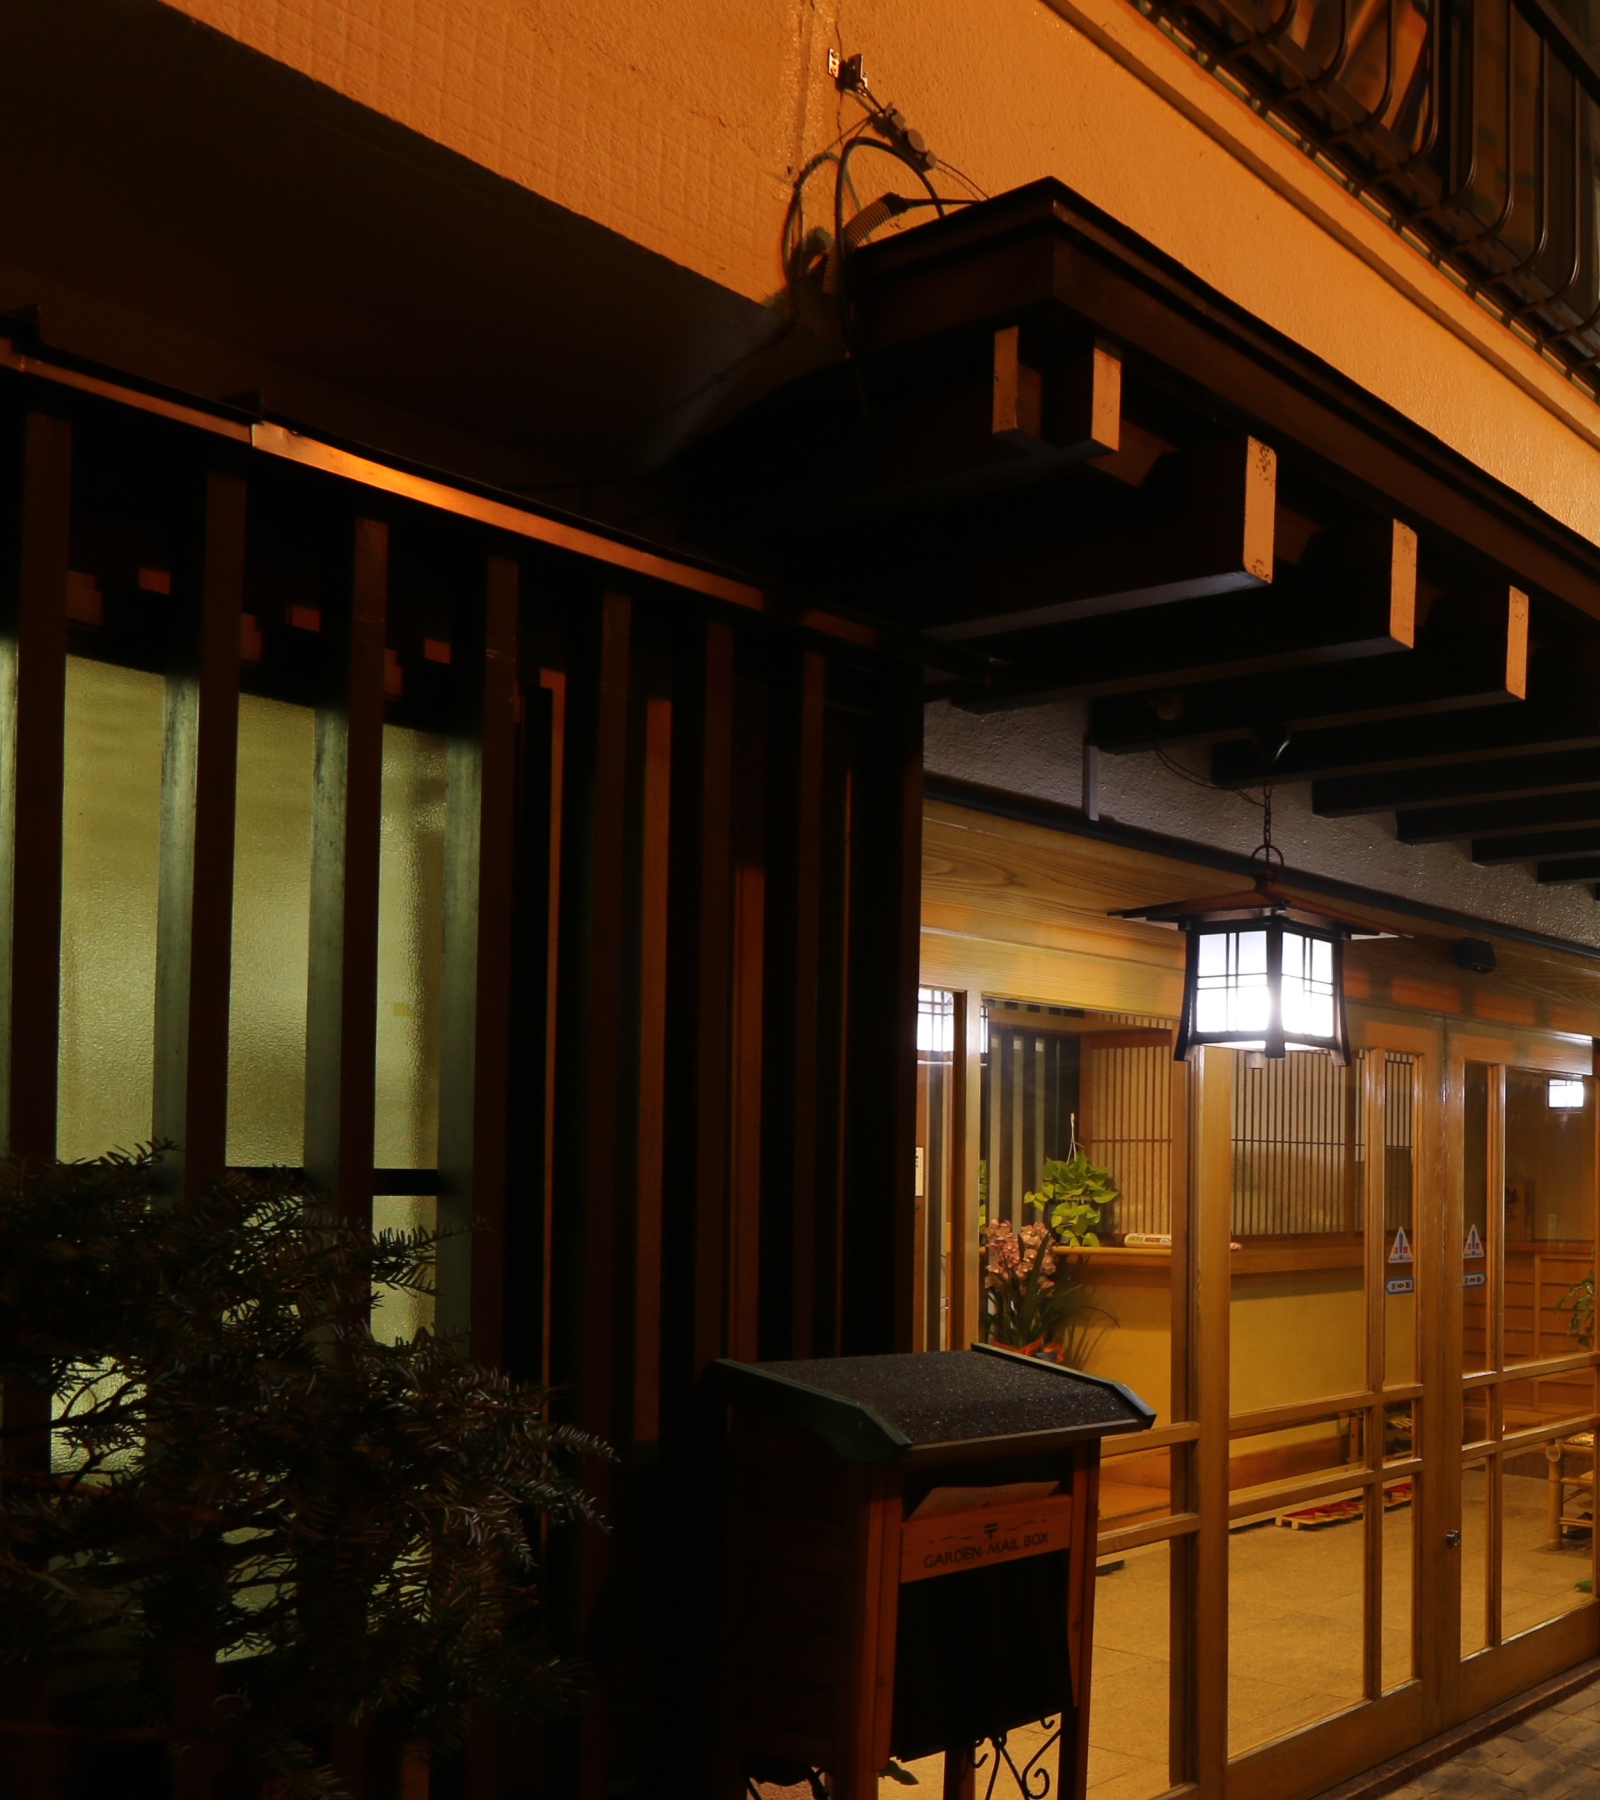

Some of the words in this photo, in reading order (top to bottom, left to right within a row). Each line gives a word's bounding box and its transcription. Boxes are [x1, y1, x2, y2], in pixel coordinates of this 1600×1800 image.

[923, 1546, 982, 1569] GARDEN
[987, 1538, 1020, 1556] MAIL
[1024, 1531, 1049, 1548] BOX
